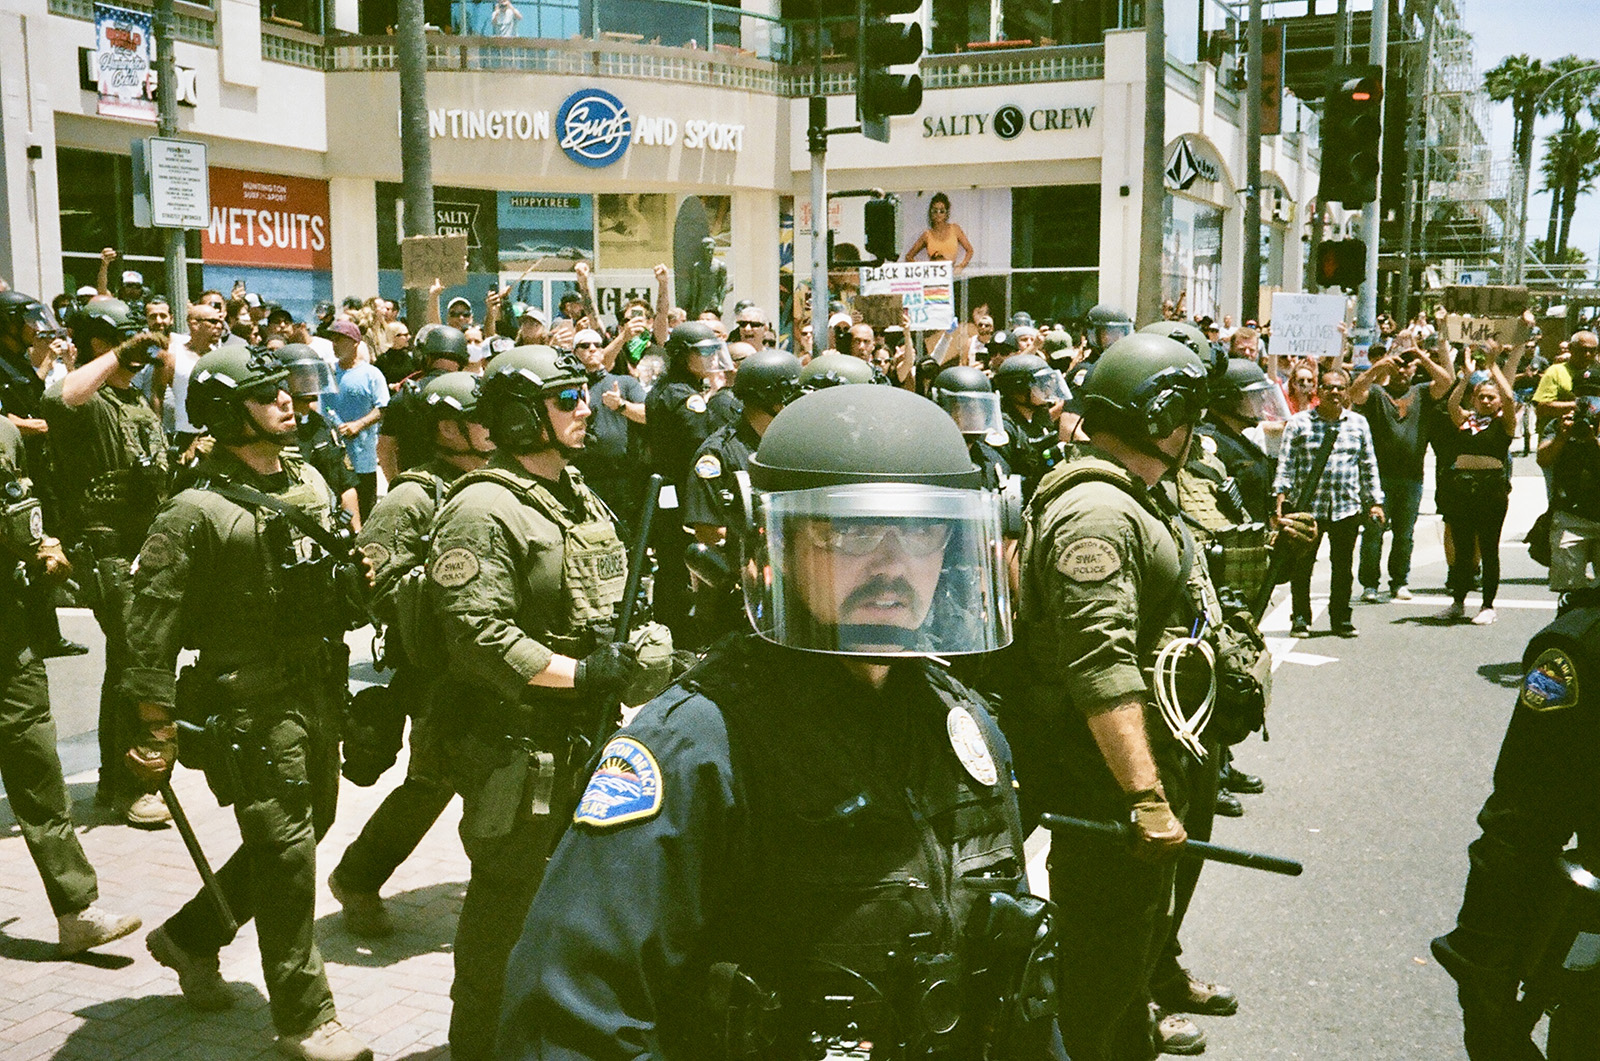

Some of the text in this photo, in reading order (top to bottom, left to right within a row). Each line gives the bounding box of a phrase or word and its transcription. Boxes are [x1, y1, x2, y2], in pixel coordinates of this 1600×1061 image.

[398, 106, 745, 153] NTINGTON Surf AND SPORT
[922, 113, 989, 138] SALTY
[1029, 106, 1096, 132] CREW
[242, 181, 287, 193] HUNTINGTON
[511, 197, 569, 208] HIPPYTREE
[437, 210, 471, 225] SALTY
[208, 206, 326, 251] WETSUITS
[865, 264, 947, 281] BLACK RIGHTS
[1076, 553, 1102, 564] SWAT
[444, 561, 466, 572] SWAT
[1072, 565, 1106, 576] POLICE
[630, 752, 657, 796] BEACH
